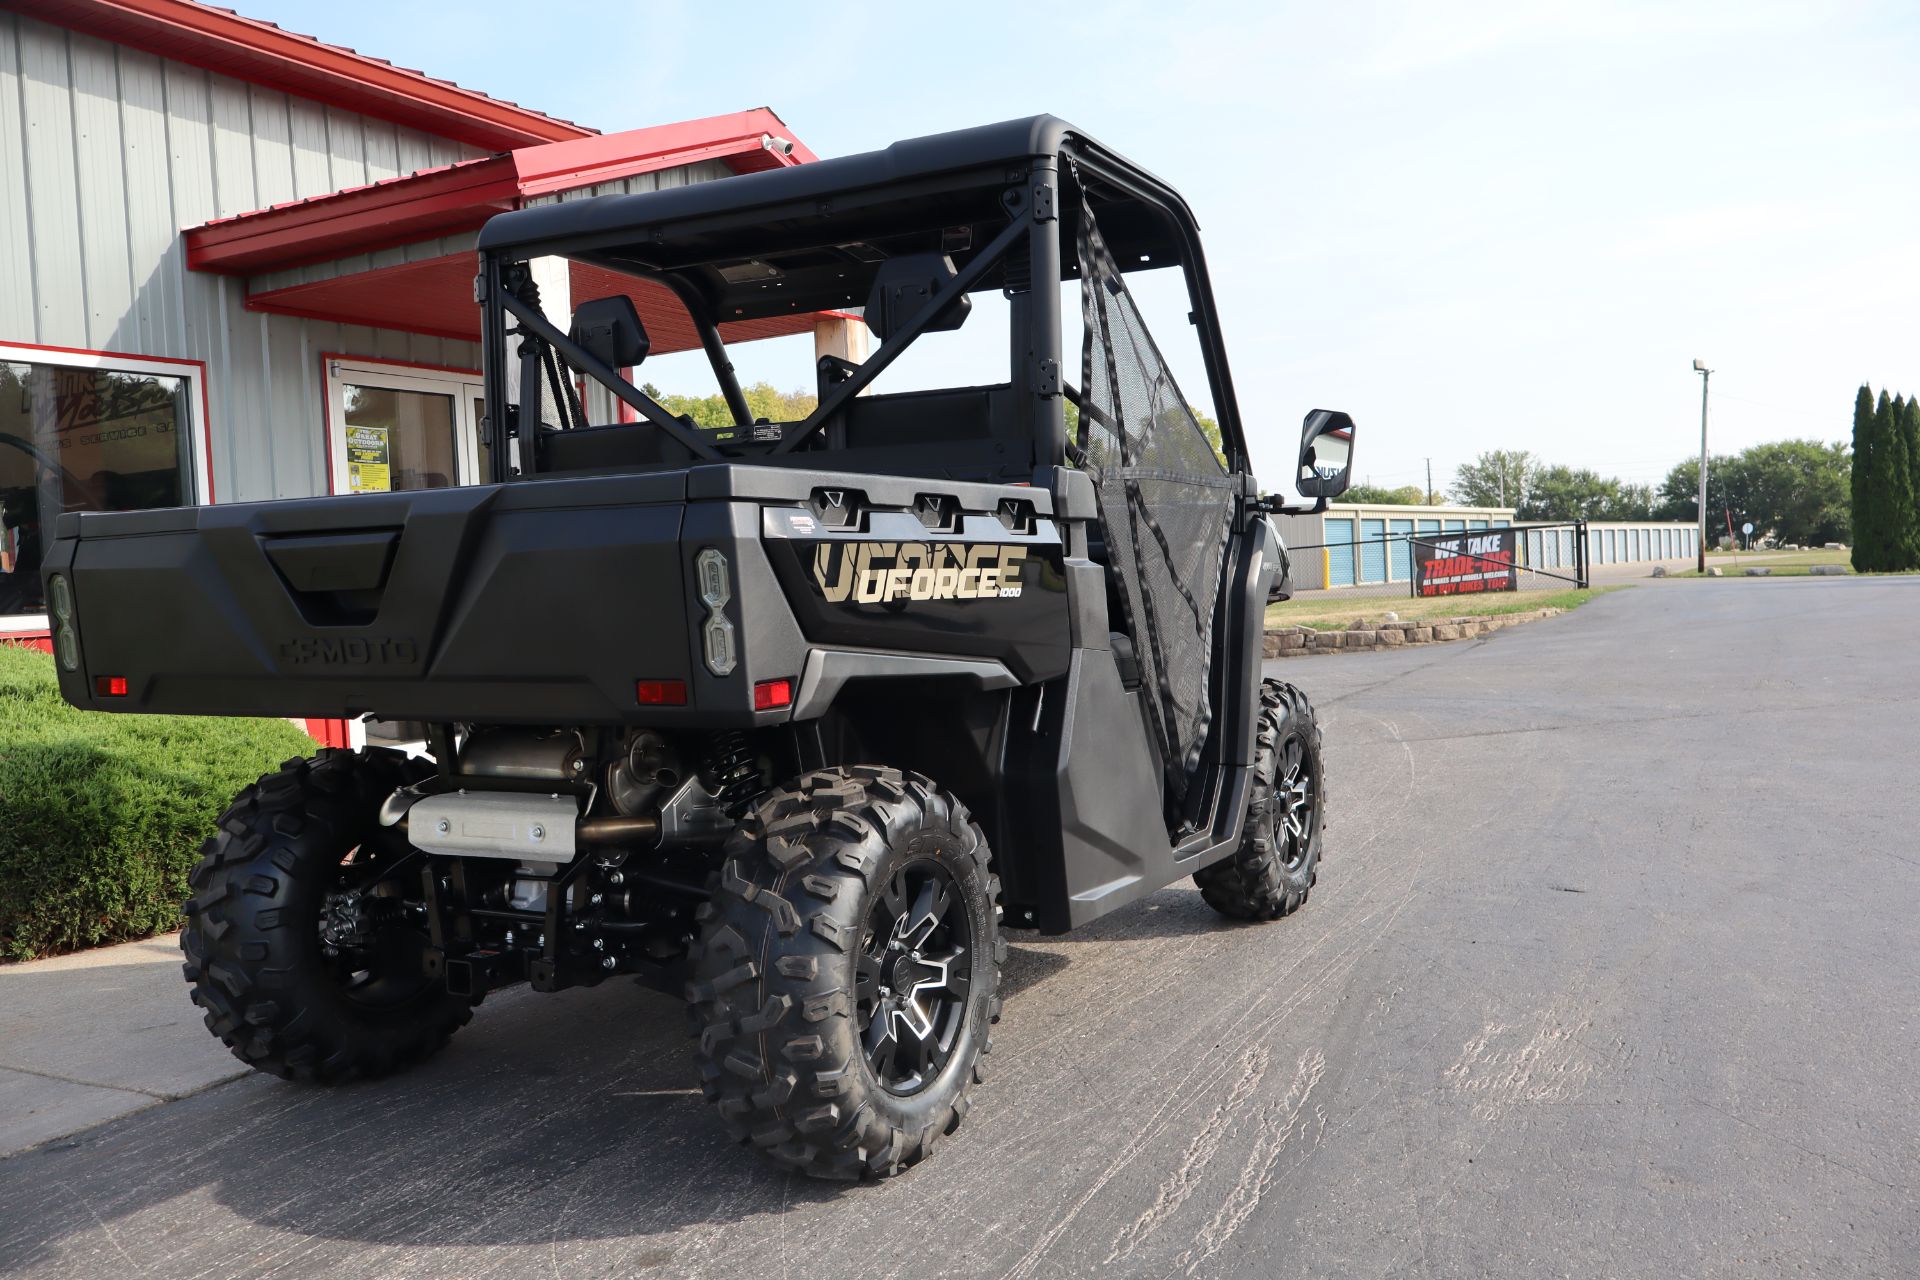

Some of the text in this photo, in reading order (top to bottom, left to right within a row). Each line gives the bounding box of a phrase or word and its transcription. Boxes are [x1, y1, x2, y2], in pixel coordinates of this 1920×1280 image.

[348, 437, 384, 446] OUTDOORS
[356, 432, 378, 441] GREAT
[1434, 534, 1502, 560] WE TAKE
[1424, 550, 1511, 579] TRADE-INS
[858, 568, 1001, 603] UFORCE
[1422, 578, 1431, 587] ALL
[1423, 585, 1436, 596] WE
[1438, 583, 1457, 594] BUY
[1459, 579, 1484, 591] BIKES
